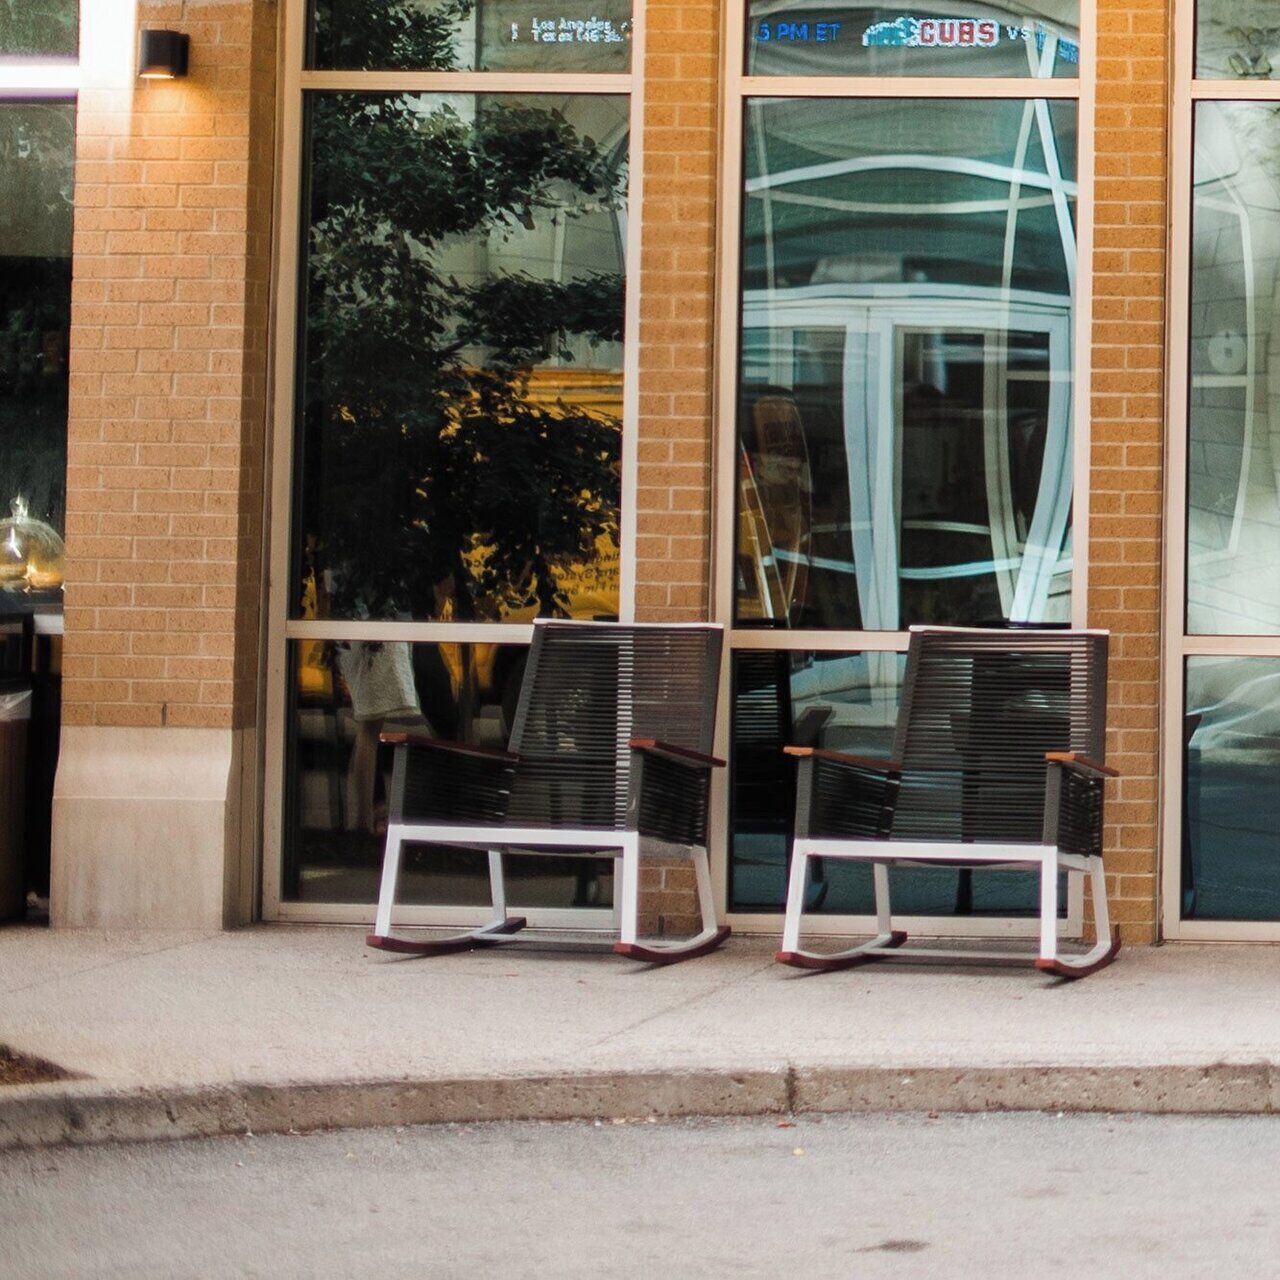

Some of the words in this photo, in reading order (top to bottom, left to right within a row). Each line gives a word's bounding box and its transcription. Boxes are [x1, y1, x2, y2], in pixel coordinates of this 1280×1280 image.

[776, 22, 809, 41] PM
[815, 22, 842, 42] ET
[918, 18, 999, 47] CUBS
